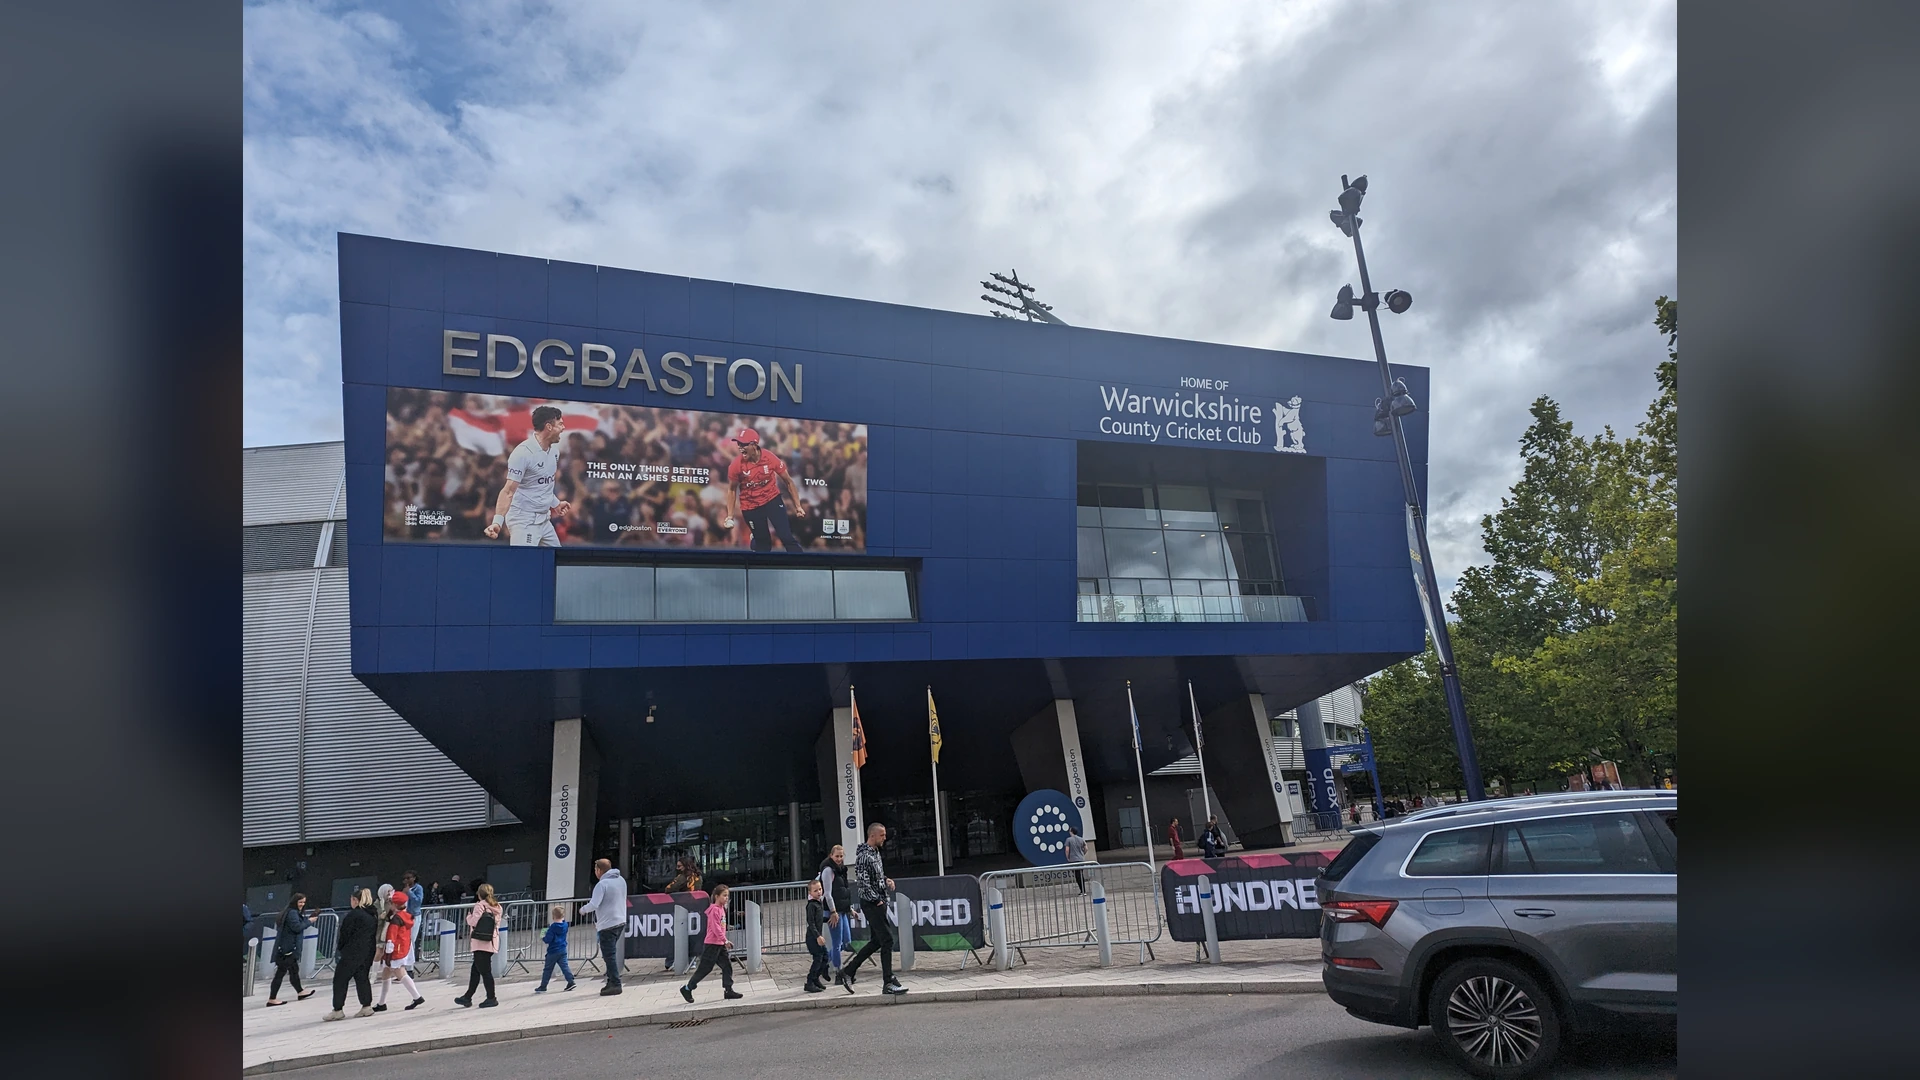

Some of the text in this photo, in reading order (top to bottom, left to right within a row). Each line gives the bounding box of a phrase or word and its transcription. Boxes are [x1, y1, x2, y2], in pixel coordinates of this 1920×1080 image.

[443, 329, 803, 404] EDGBASTON
[1180, 376, 1229, 391] HOME OF
[1100, 386, 1262, 424] Warwickshire
[1100, 416, 1262, 445] County Cricket Club
[586, 471, 710, 484] THAN AN ASHES SERIES?
[587, 462, 710, 476] THE ONLY THING BETTER
[804, 478, 828, 487] TWO.
[618, 523, 652, 532] edgbaston
[1069, 748, 1081, 795] edgbaston
[1265, 738, 1278, 781] edgbaston
[845, 763, 855, 814] edgbaston
[558, 784, 570, 842] edgbaston
[1174, 886, 1185, 904] THE
[1176, 879, 1322, 915] HUNDRE
[624, 911, 701, 938] UNDRD
